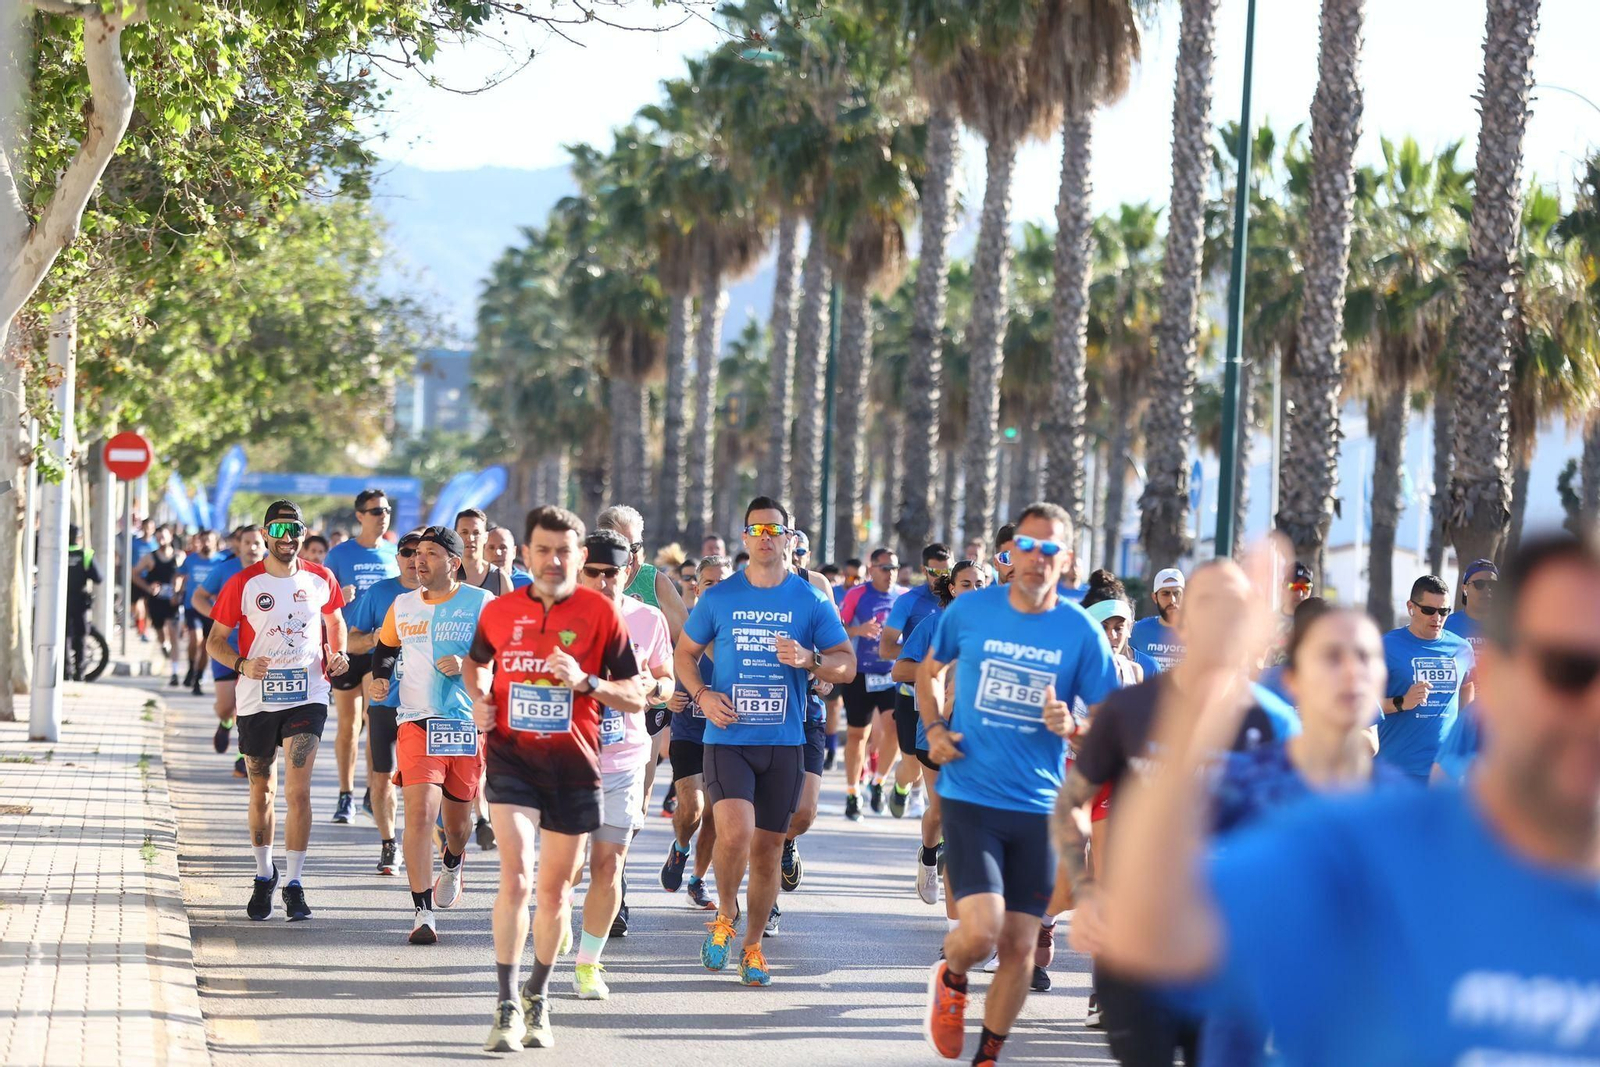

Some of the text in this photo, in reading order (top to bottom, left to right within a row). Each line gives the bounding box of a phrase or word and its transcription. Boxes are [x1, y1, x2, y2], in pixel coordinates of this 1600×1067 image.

[353, 563, 387, 571] mayor
[732, 610, 793, 623] mayoral
[399, 620, 430, 637] Trail
[434, 621, 473, 632] MONTE
[434, 631, 473, 642] HACHO
[736, 636, 779, 645] MAKE
[736, 644, 777, 652] FRIEND
[983, 639, 1062, 665] mayoral
[1147, 643, 1188, 653] mayora
[1421, 670, 1453, 681] 1897
[266, 680, 303, 692] 2151
[989, 681, 1042, 704] 2196
[517, 702, 564, 717] 1682
[740, 700, 780, 711] 1819
[602, 720, 621, 732] 63
[433, 732, 472, 743] 2150
